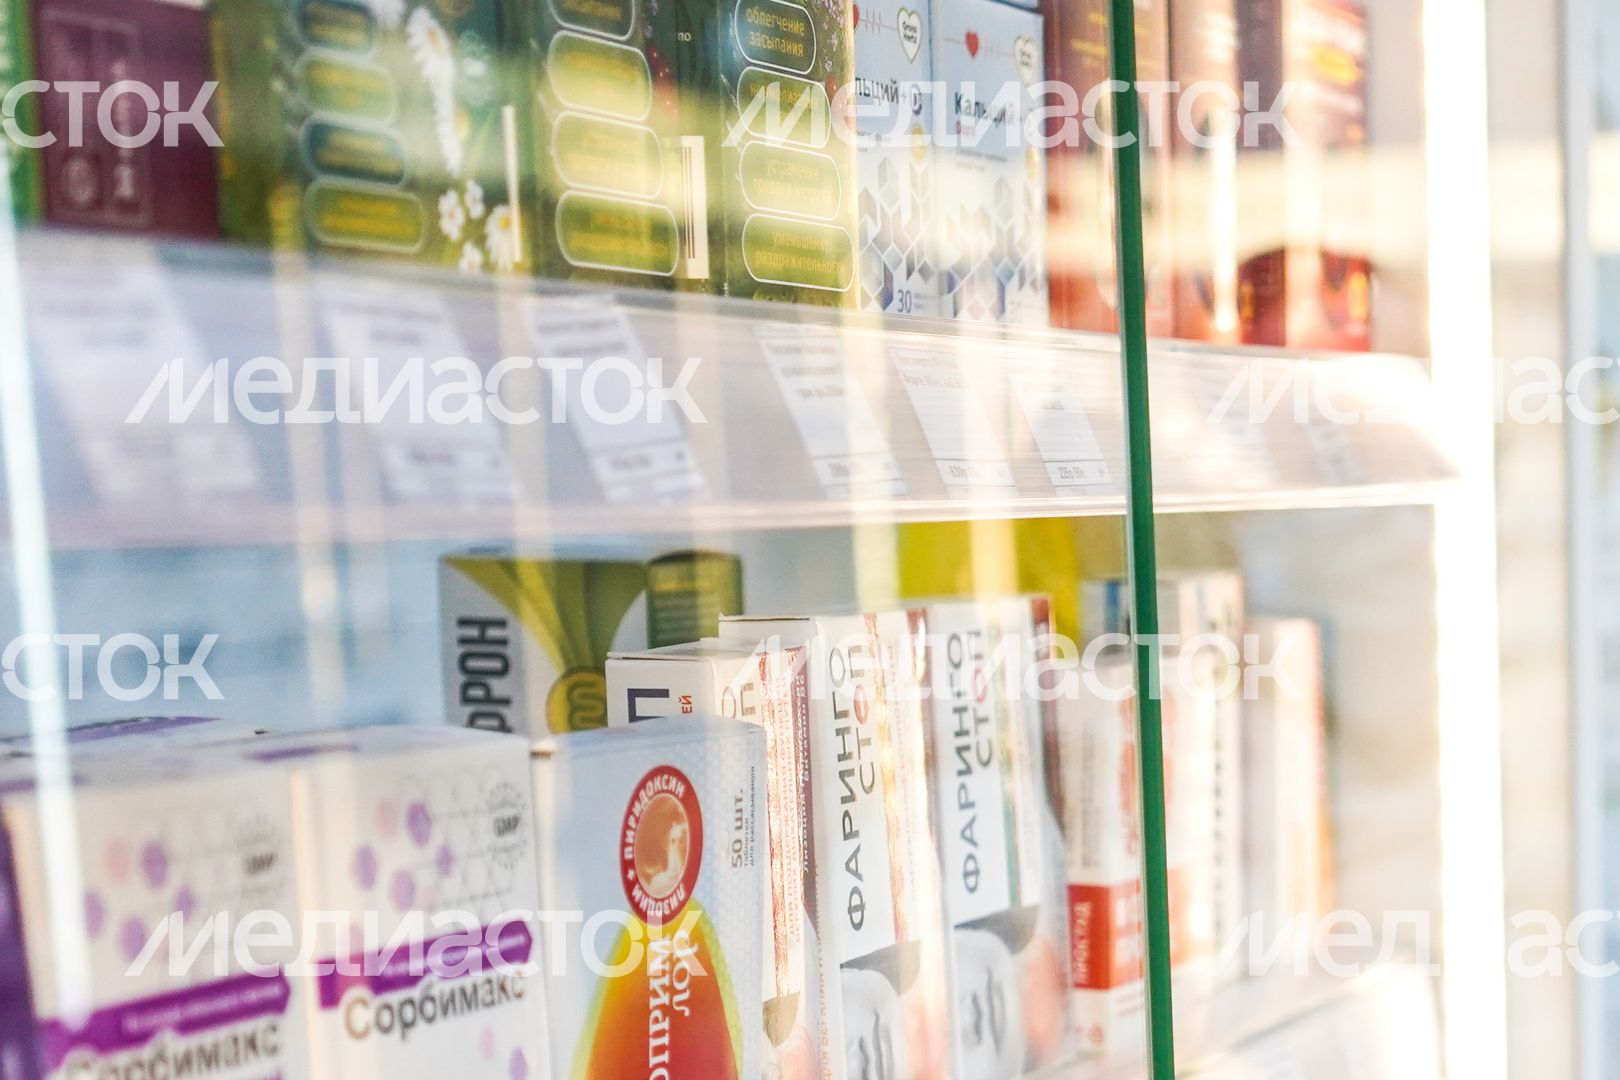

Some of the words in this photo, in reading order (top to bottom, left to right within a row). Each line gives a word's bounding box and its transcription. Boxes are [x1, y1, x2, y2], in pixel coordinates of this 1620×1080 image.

[848, 645, 875, 795] СТОП
[948, 632, 980, 894] ФАРИНГО
[622, 773, 687, 861] ПИРИДОКСИН
[829, 647, 866, 931] ФАРИНГО
[731, 840, 744, 869] 50
[344, 970, 526, 1043] Сорбимакс
